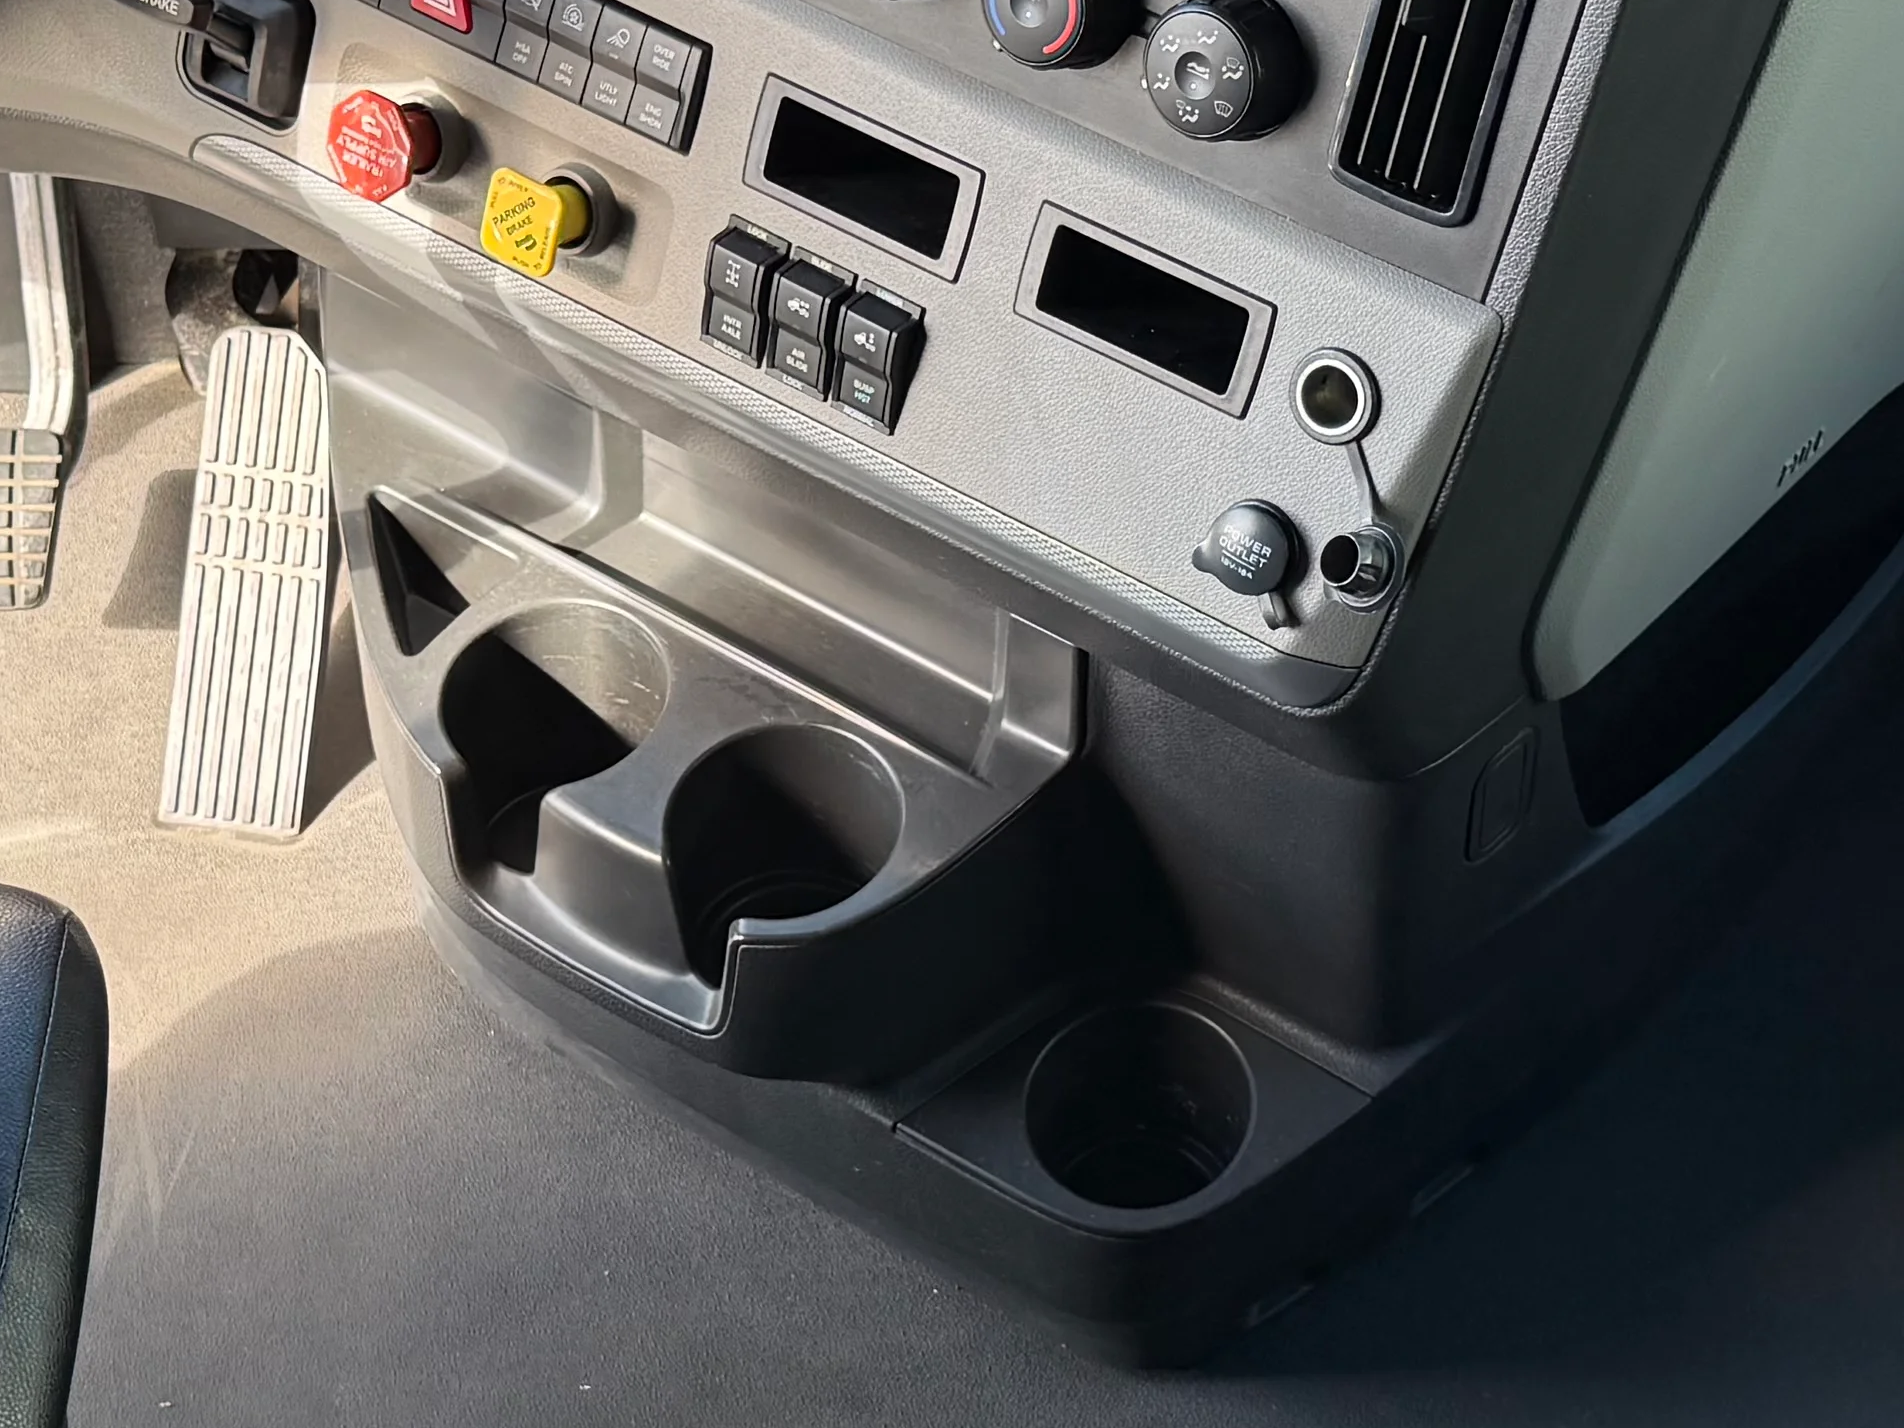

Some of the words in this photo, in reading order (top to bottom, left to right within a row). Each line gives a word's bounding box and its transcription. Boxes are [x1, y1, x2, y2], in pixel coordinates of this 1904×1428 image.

[653, 43, 676, 59] OVER
[595, 91, 617, 107] LIGHT
[645, 102, 662, 117] ENG
[336, 134, 377, 161] SUPPLY
[342, 149, 383, 177] TRAILER
[492, 196, 536, 225] PARKING
[747, 224, 768, 241] LOCK
[791, 347, 805, 360] AIR
[782, 374, 803, 391] LOCK
[1224, 525, 1272, 558] POWER
[1219, 535, 1268, 568] OUTLET
